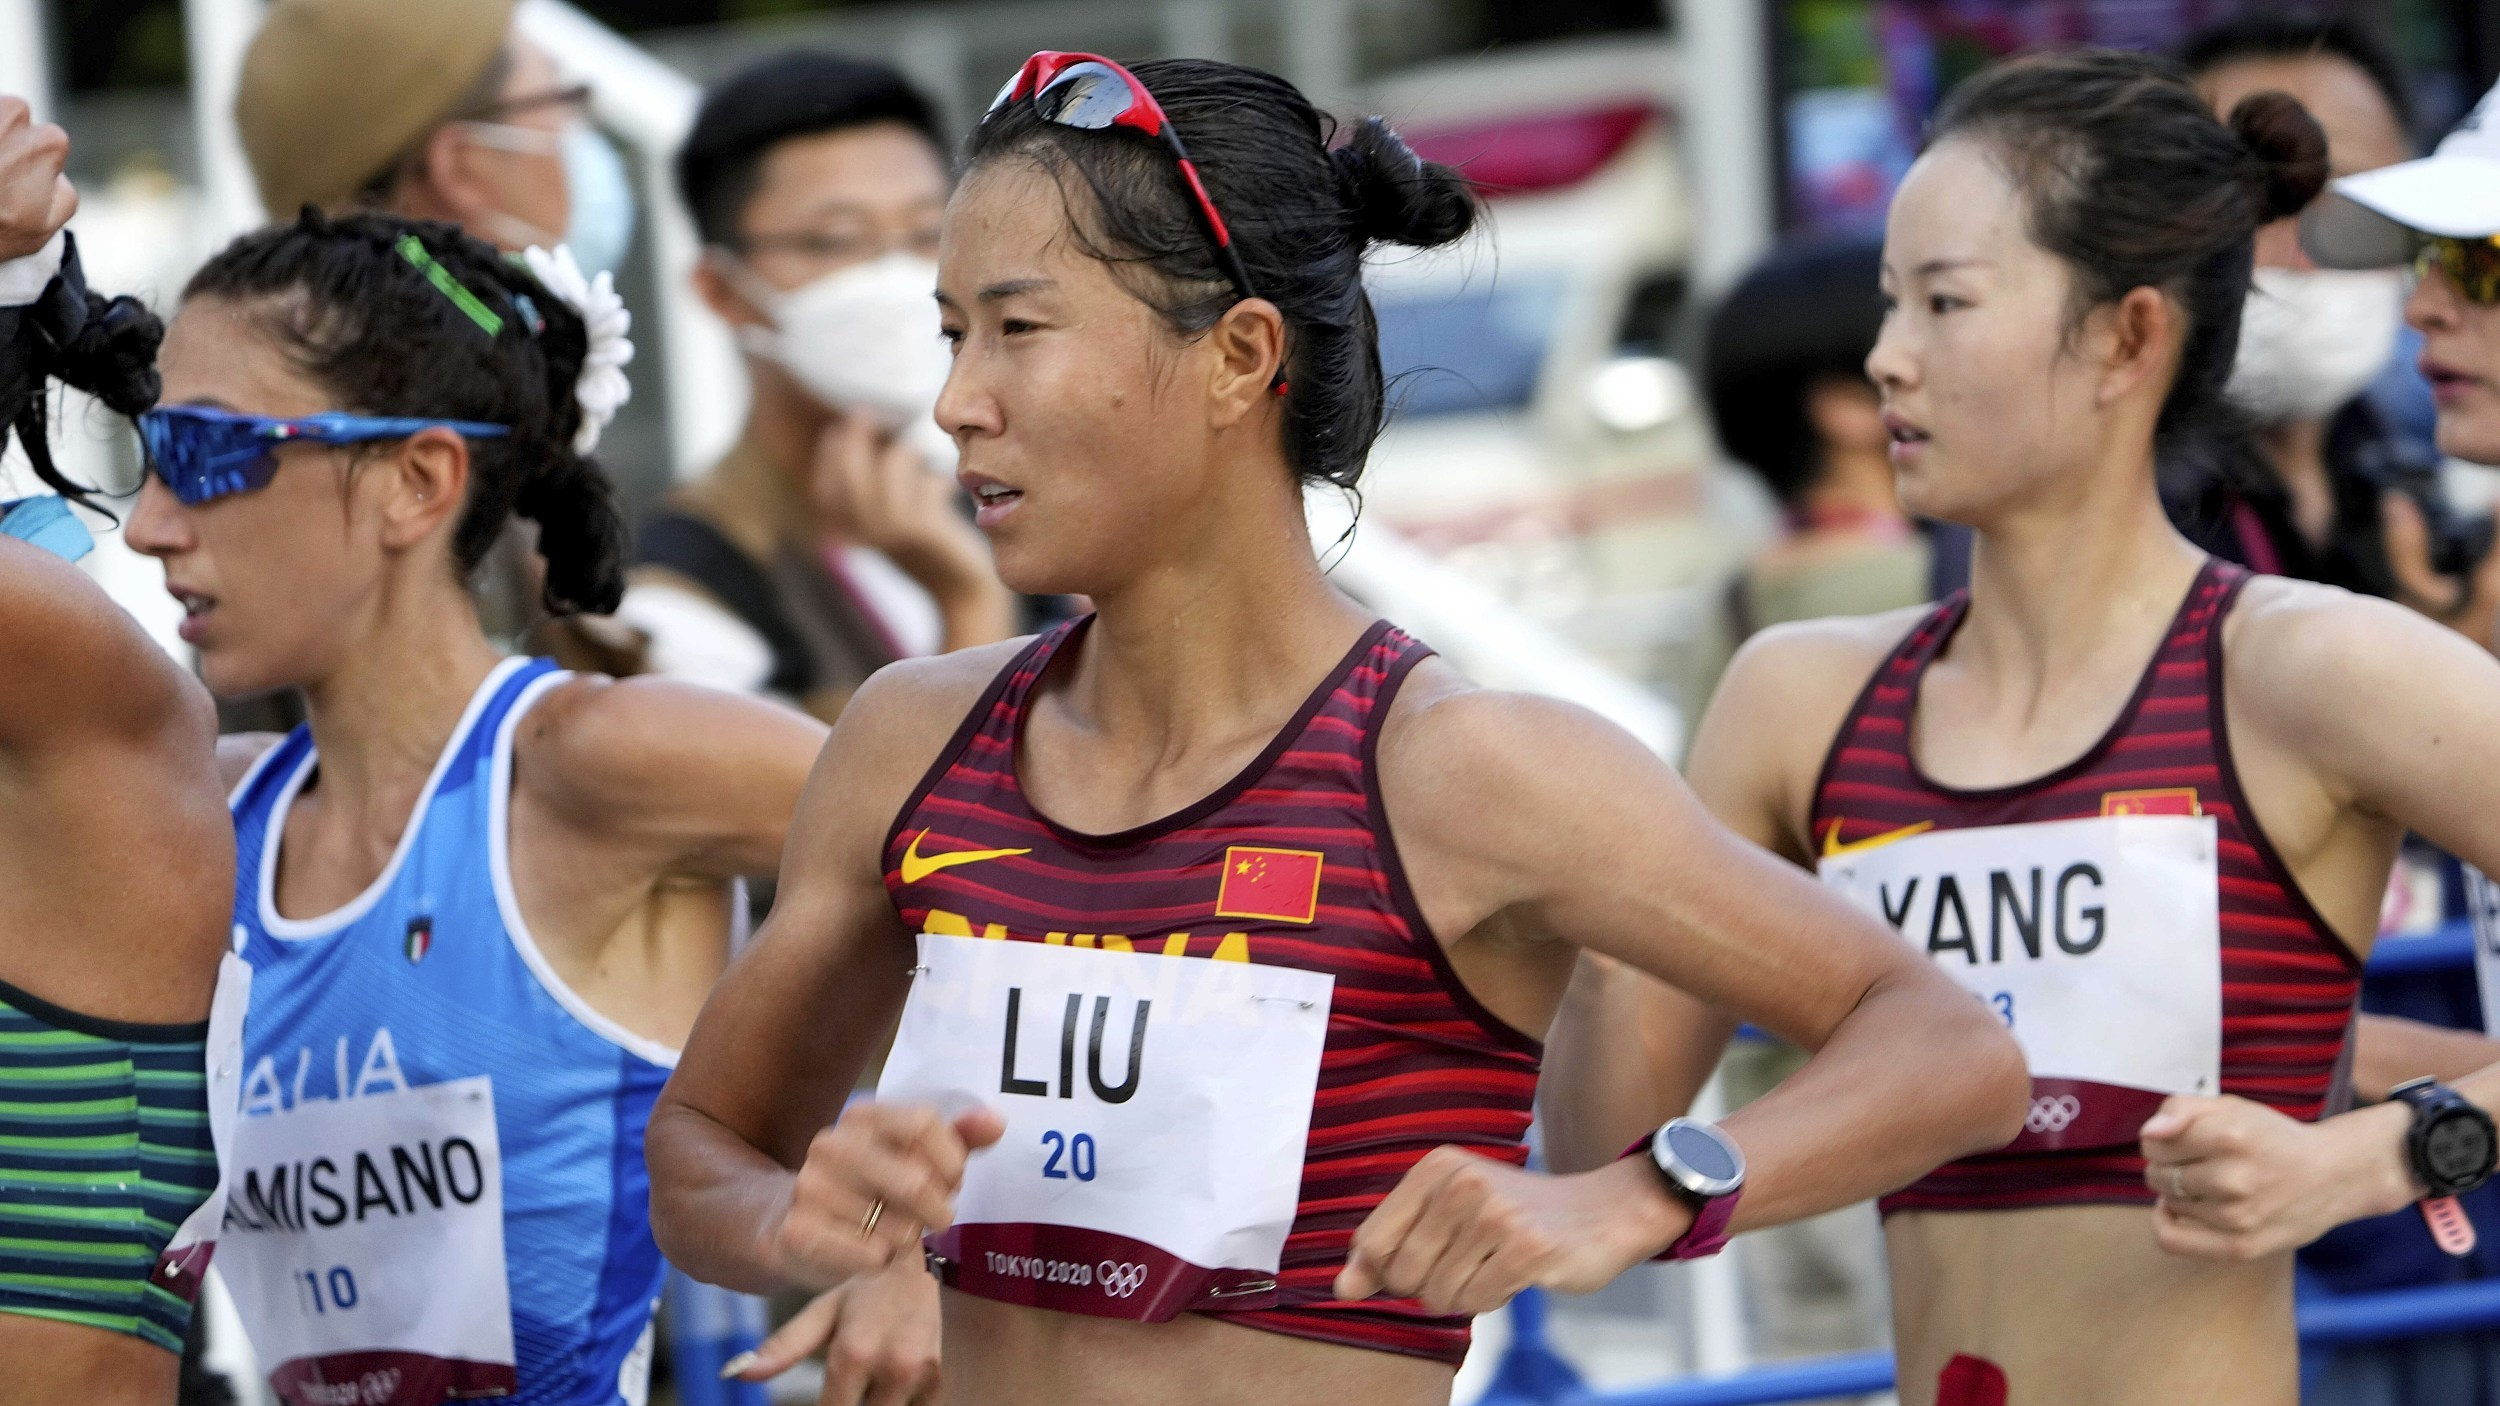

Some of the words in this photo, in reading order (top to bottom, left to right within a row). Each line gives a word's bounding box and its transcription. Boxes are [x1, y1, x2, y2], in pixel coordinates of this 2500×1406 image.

[1880, 861, 2106, 966] YANG
[1001, 987, 1151, 1104] LIU
[1042, 1130, 1097, 1182] 20
[985, 1251, 1045, 1280] TOKYO
[1046, 1259, 1092, 1287] 2020
